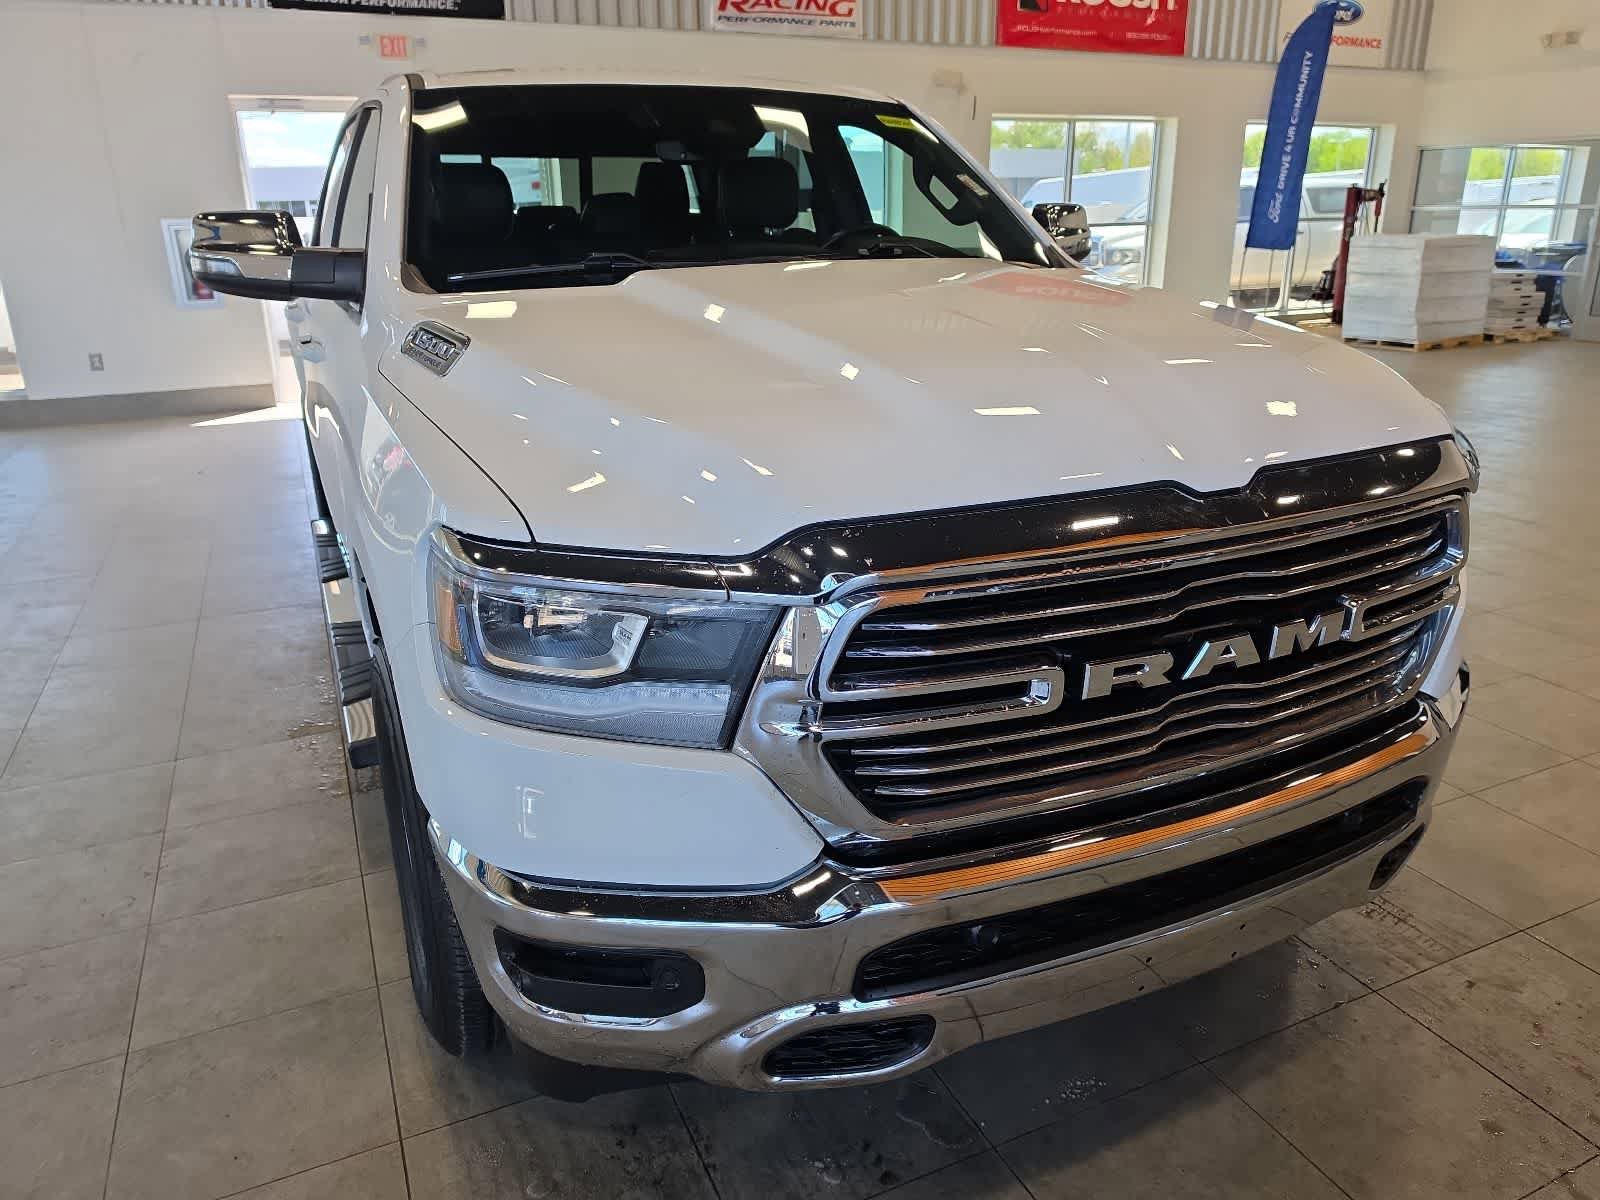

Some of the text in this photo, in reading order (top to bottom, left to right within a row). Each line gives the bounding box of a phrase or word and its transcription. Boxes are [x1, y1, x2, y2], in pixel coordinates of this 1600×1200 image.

[717, 15, 856, 28] PERFORMANCE PARTS
[380, 36, 407, 57] EXIT
[1330, 35, 1382, 48] FORMANCE
[1267, 192, 1283, 223] Ford
[1277, 154, 1292, 190] DRIVE
[1286, 126, 1297, 143] UR
[1081, 609, 1347, 700] RAM
